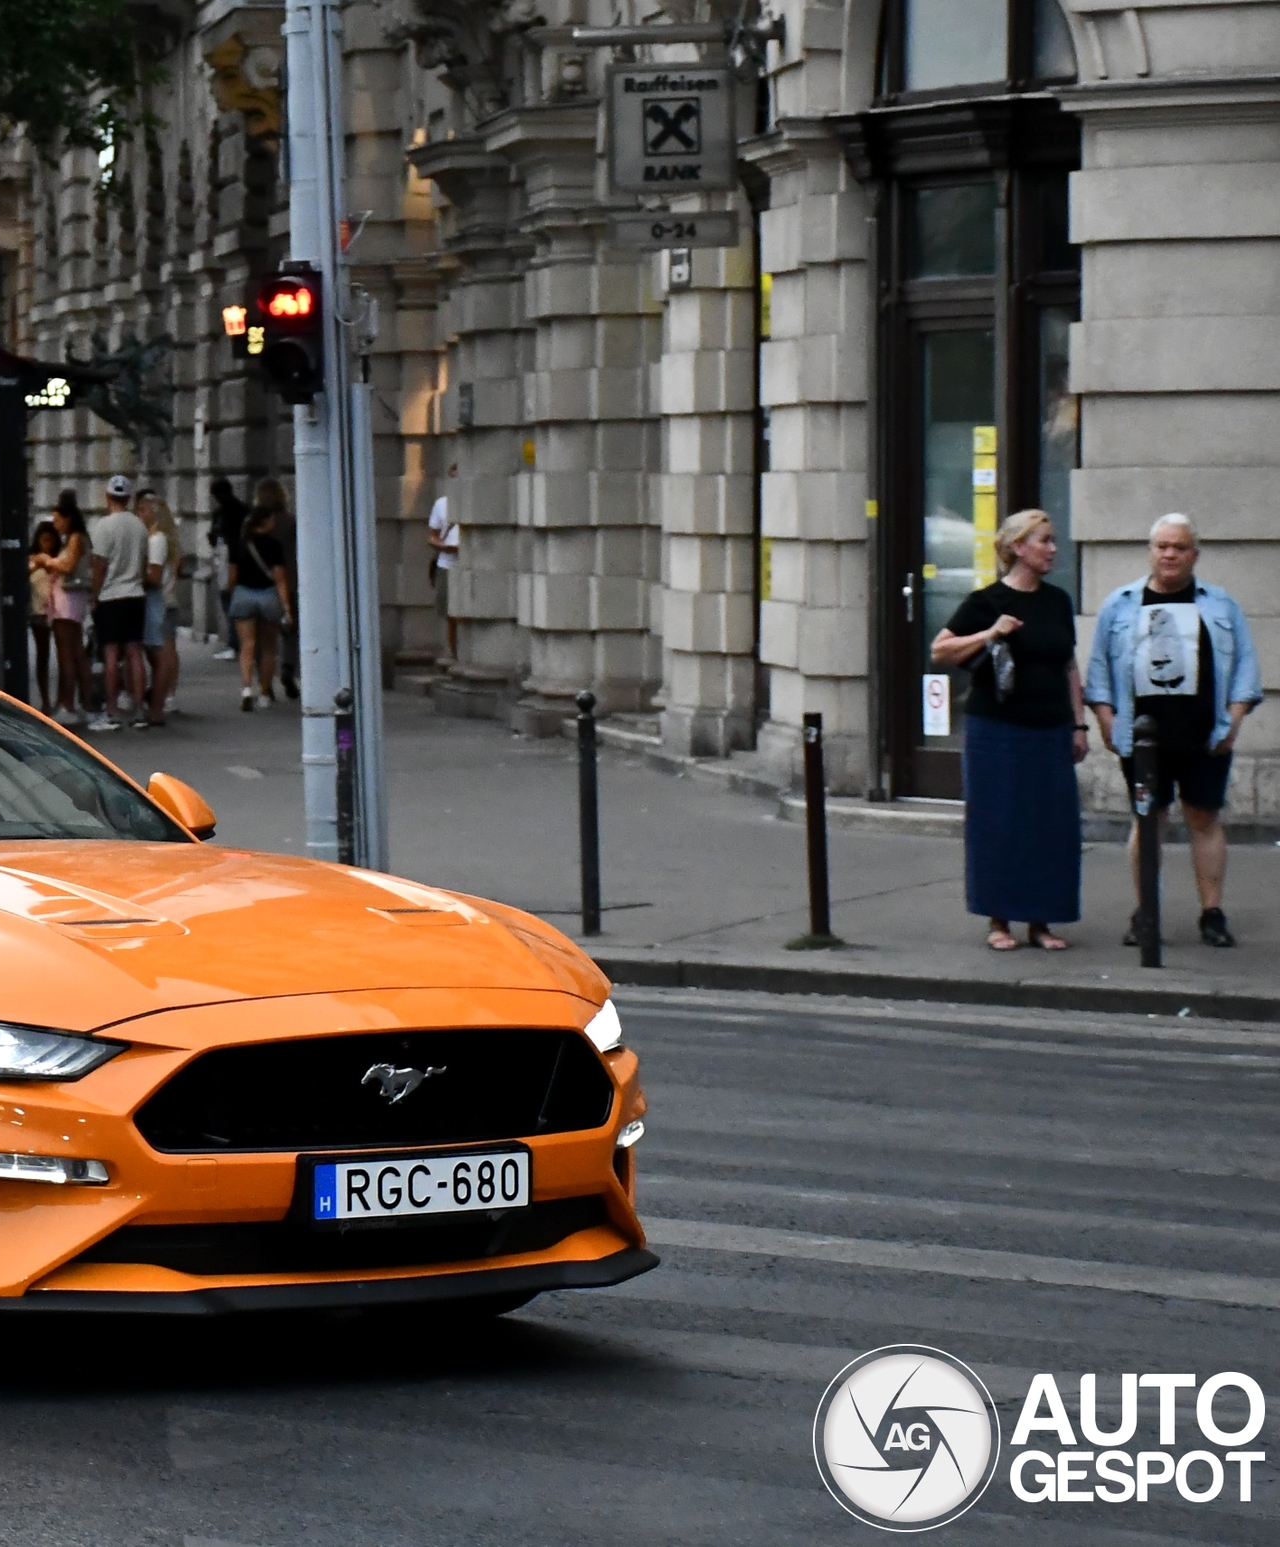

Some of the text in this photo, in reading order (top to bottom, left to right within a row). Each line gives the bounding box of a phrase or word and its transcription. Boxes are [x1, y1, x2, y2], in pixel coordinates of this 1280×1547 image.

[624, 74, 718, 92] Raiffeisen
[644, 164, 701, 182] BANK
[651, 222, 697, 239] 0-24
[320, 1158, 519, 1212] H RGC-680
